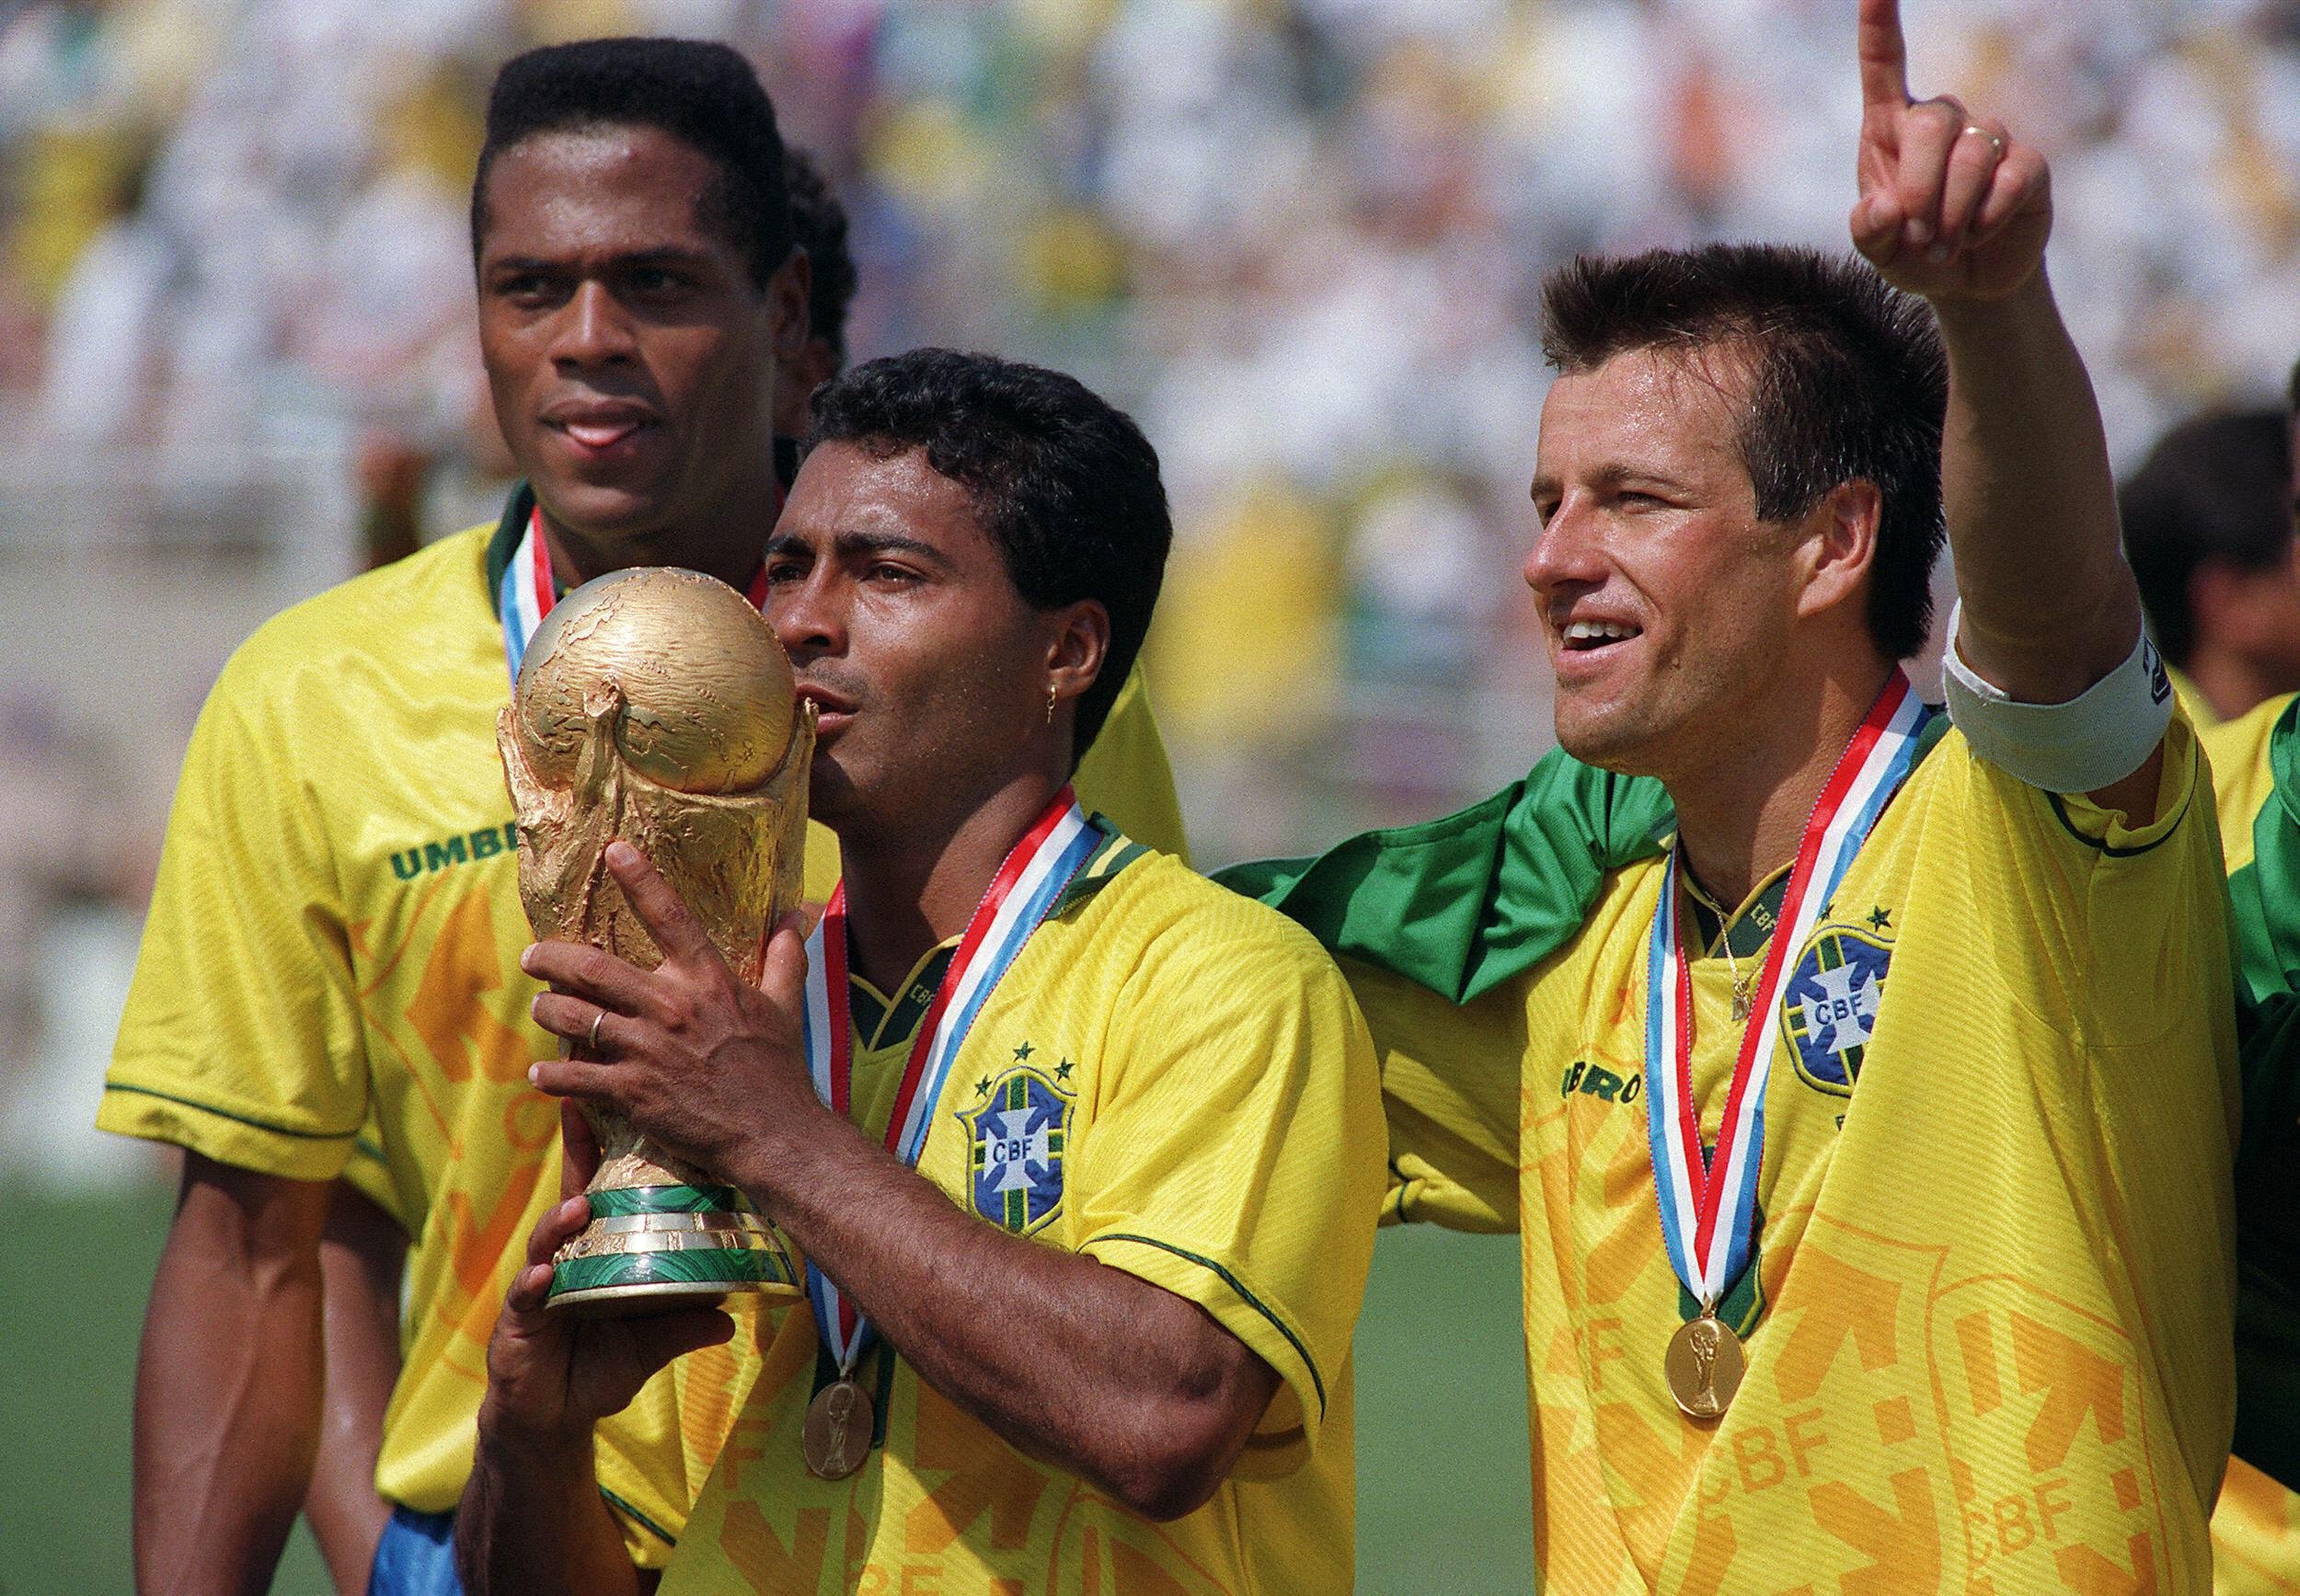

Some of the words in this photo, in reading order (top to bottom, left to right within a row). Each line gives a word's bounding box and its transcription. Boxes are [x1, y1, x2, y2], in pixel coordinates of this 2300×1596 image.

[1814, 992, 1861, 1026] CBF
[1561, 1061, 1641, 1103] BRO
[993, 1137, 1032, 1164] CBF
[1697, 1407, 1829, 1505] CBF
[1964, 1477, 2072, 1569] CBF
